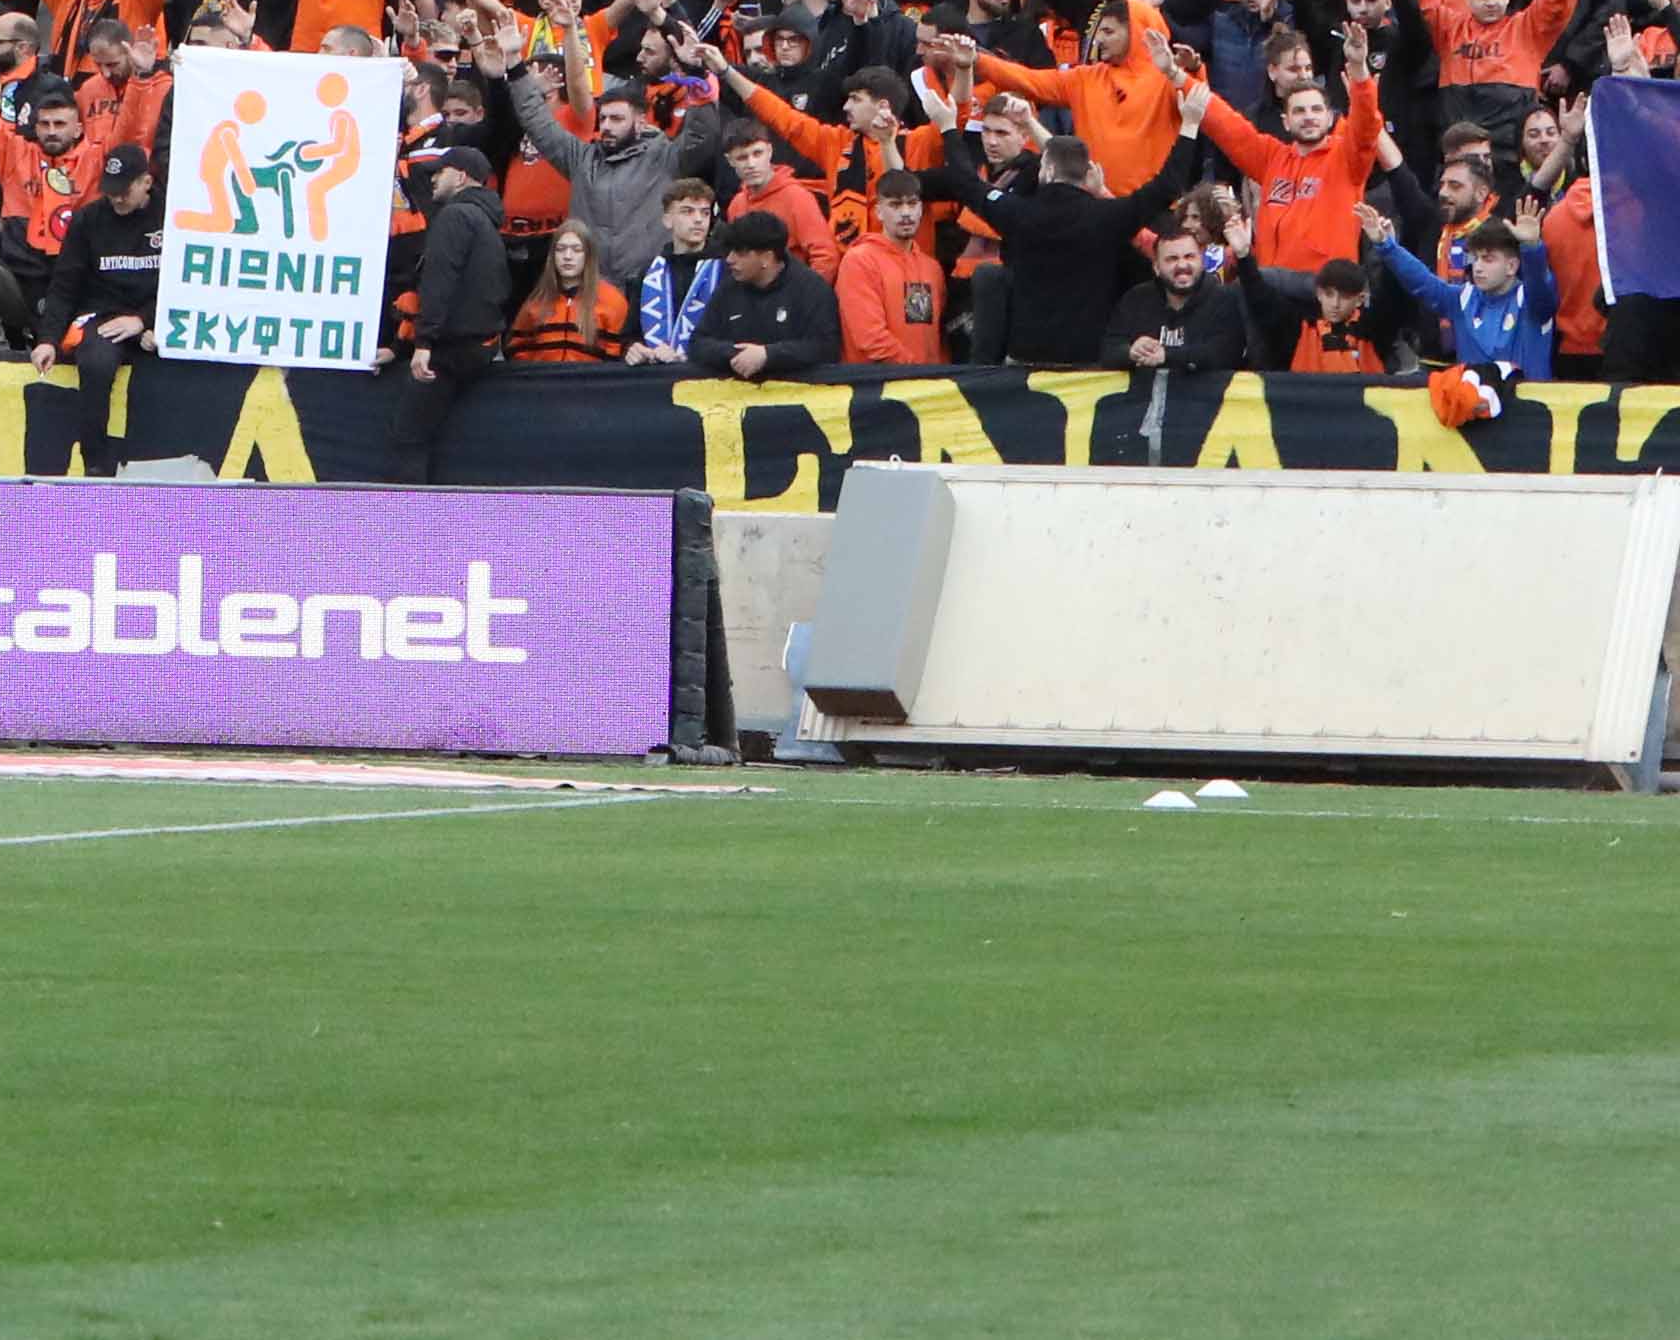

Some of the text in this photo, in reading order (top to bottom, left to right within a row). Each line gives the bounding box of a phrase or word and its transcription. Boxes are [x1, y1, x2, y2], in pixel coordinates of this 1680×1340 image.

[86, 98, 122, 119] APO
[182, 243, 362, 295] ΑΙΩΝΙΑ
[166, 309, 363, 360] ΣΚΥΦΤΟΙ
